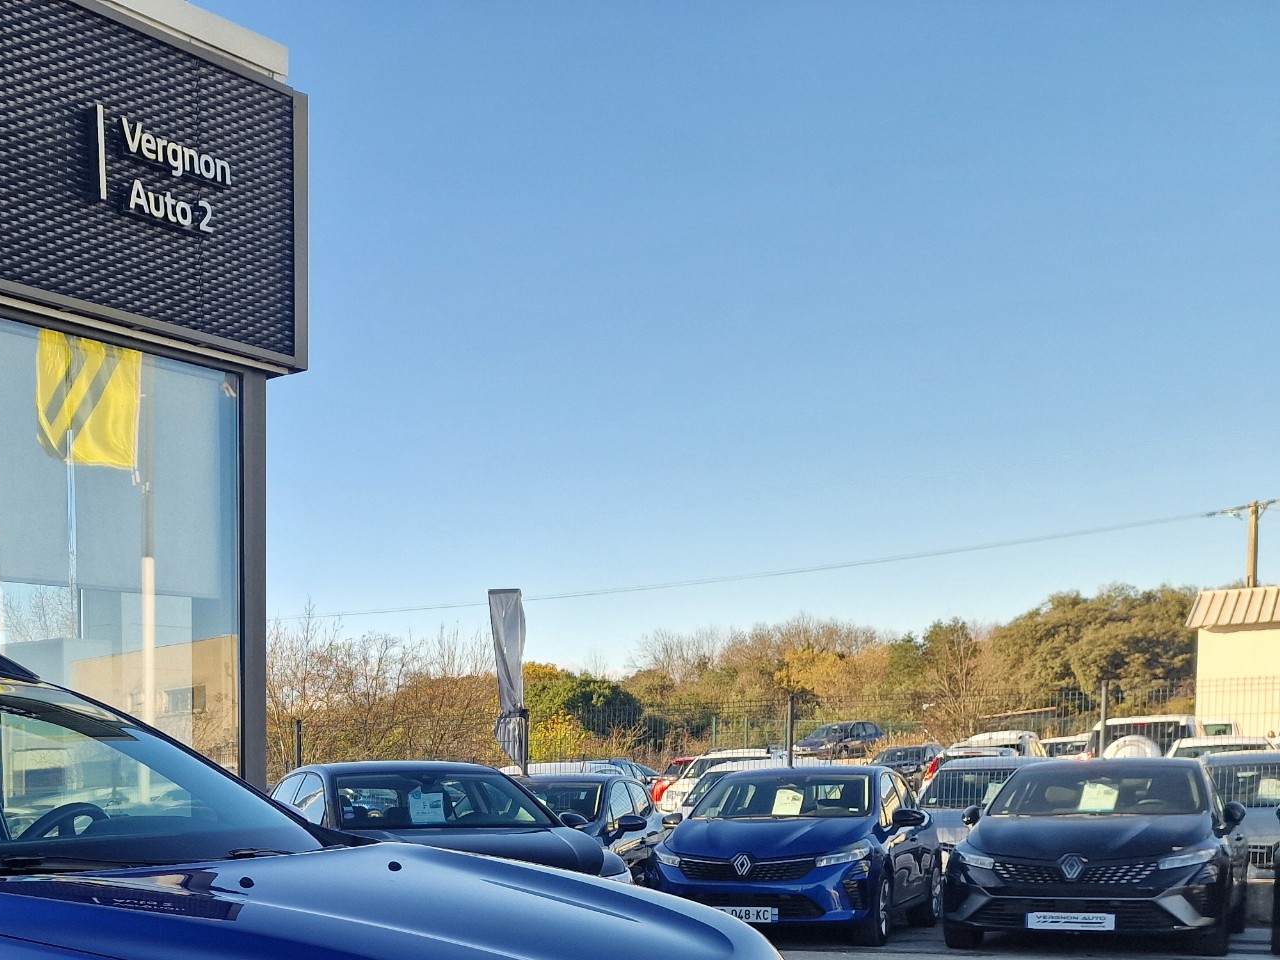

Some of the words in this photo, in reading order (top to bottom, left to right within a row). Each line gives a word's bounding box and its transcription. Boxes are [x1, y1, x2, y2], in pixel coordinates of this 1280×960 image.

[121, 116, 232, 185] Vergnon
[130, 179, 192, 226] Auto
[198, 200, 214, 233] 2
[716, 908, 769, 921] -048-KC
